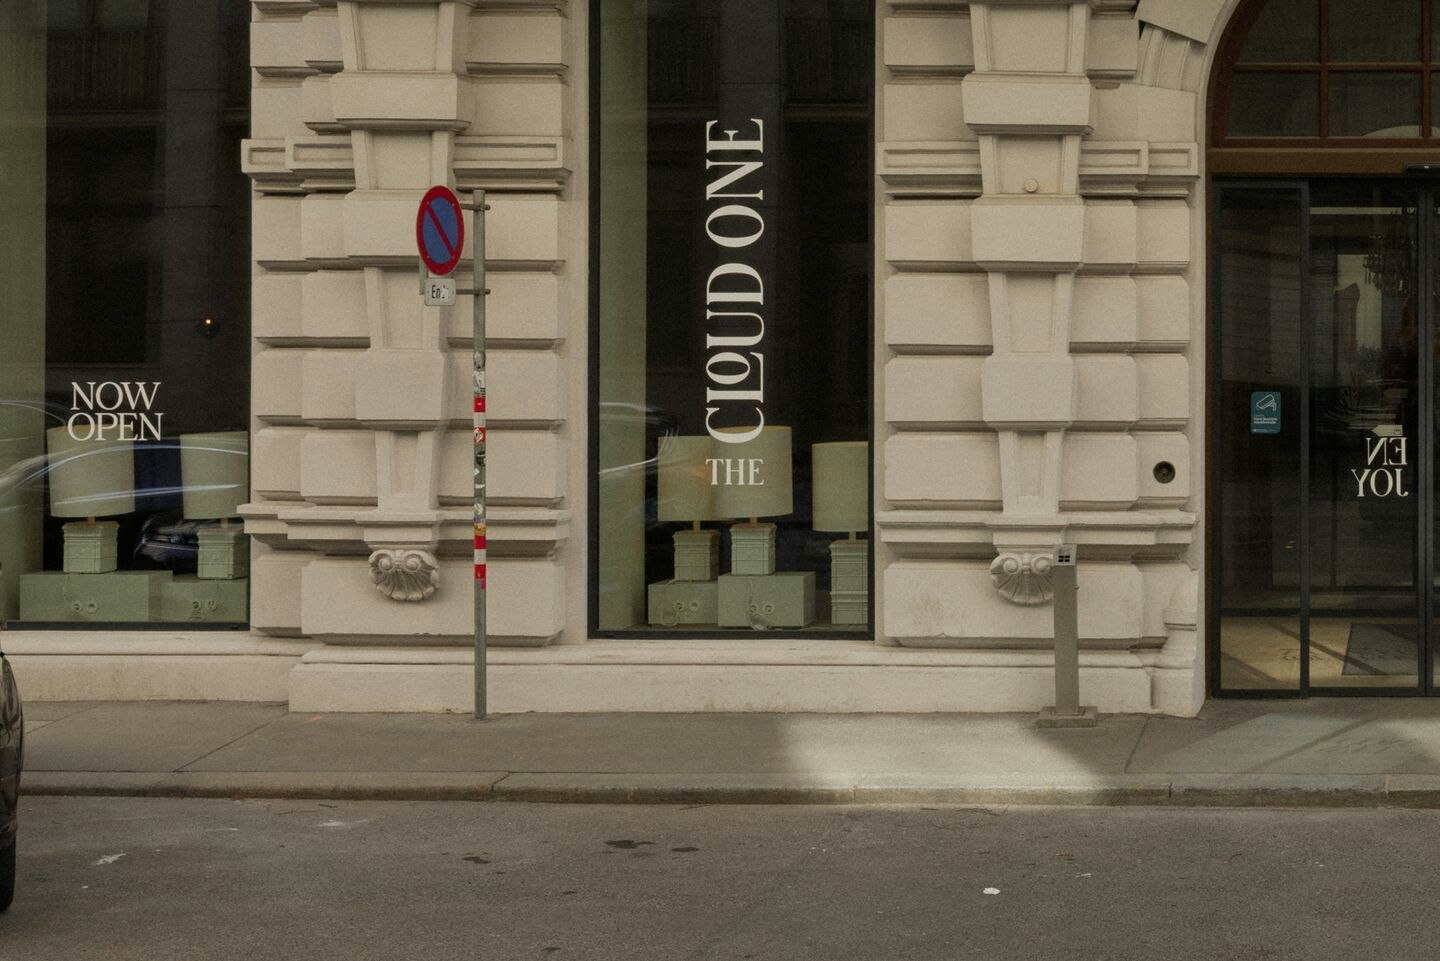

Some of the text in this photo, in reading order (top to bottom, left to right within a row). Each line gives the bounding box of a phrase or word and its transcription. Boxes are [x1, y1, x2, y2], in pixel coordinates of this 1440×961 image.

[706, 118, 765, 486] THE CLOUD ONE
[70, 381, 162, 411] NOW
[67, 412, 164, 441] OPEN
